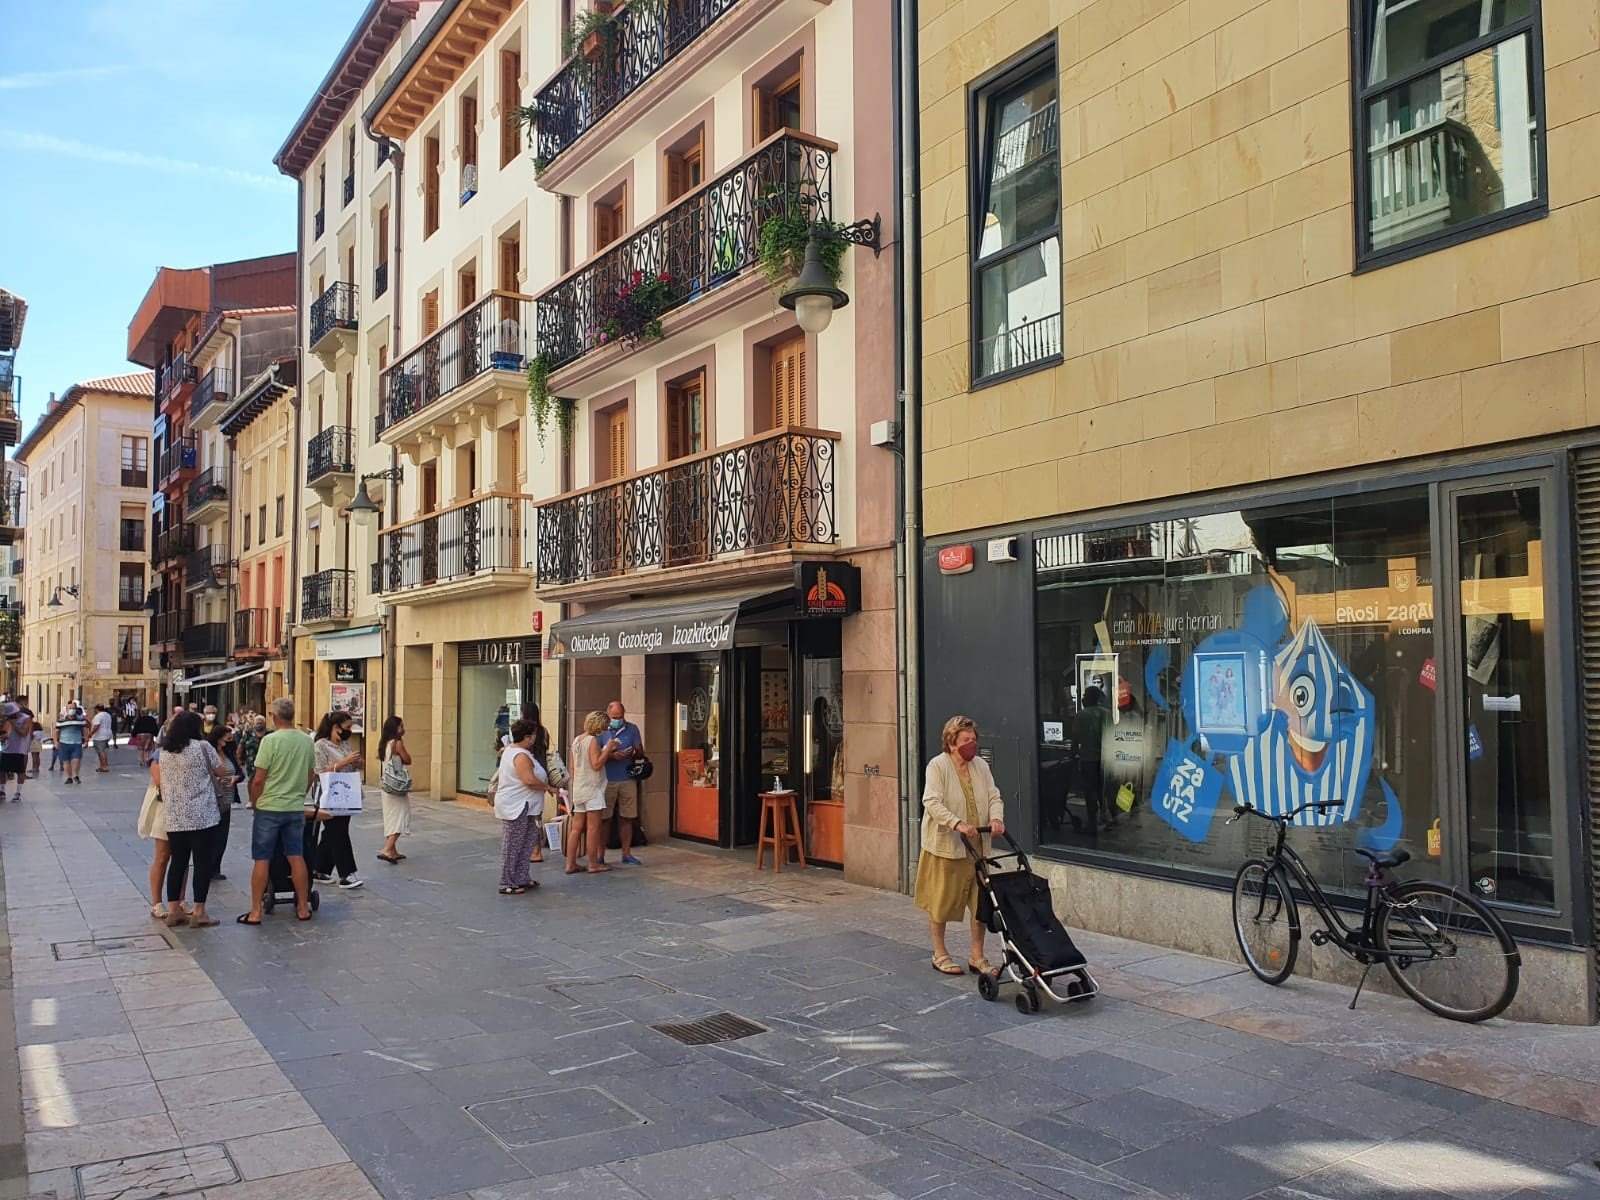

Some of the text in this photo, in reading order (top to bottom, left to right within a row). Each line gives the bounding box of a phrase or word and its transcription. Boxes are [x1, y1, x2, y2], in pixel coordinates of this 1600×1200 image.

[571, 620, 730, 654] Okindegia Gozotegia Izozkitegia
[477, 643, 521, 662] VIOLET
[1170, 774, 1195, 803] RA
